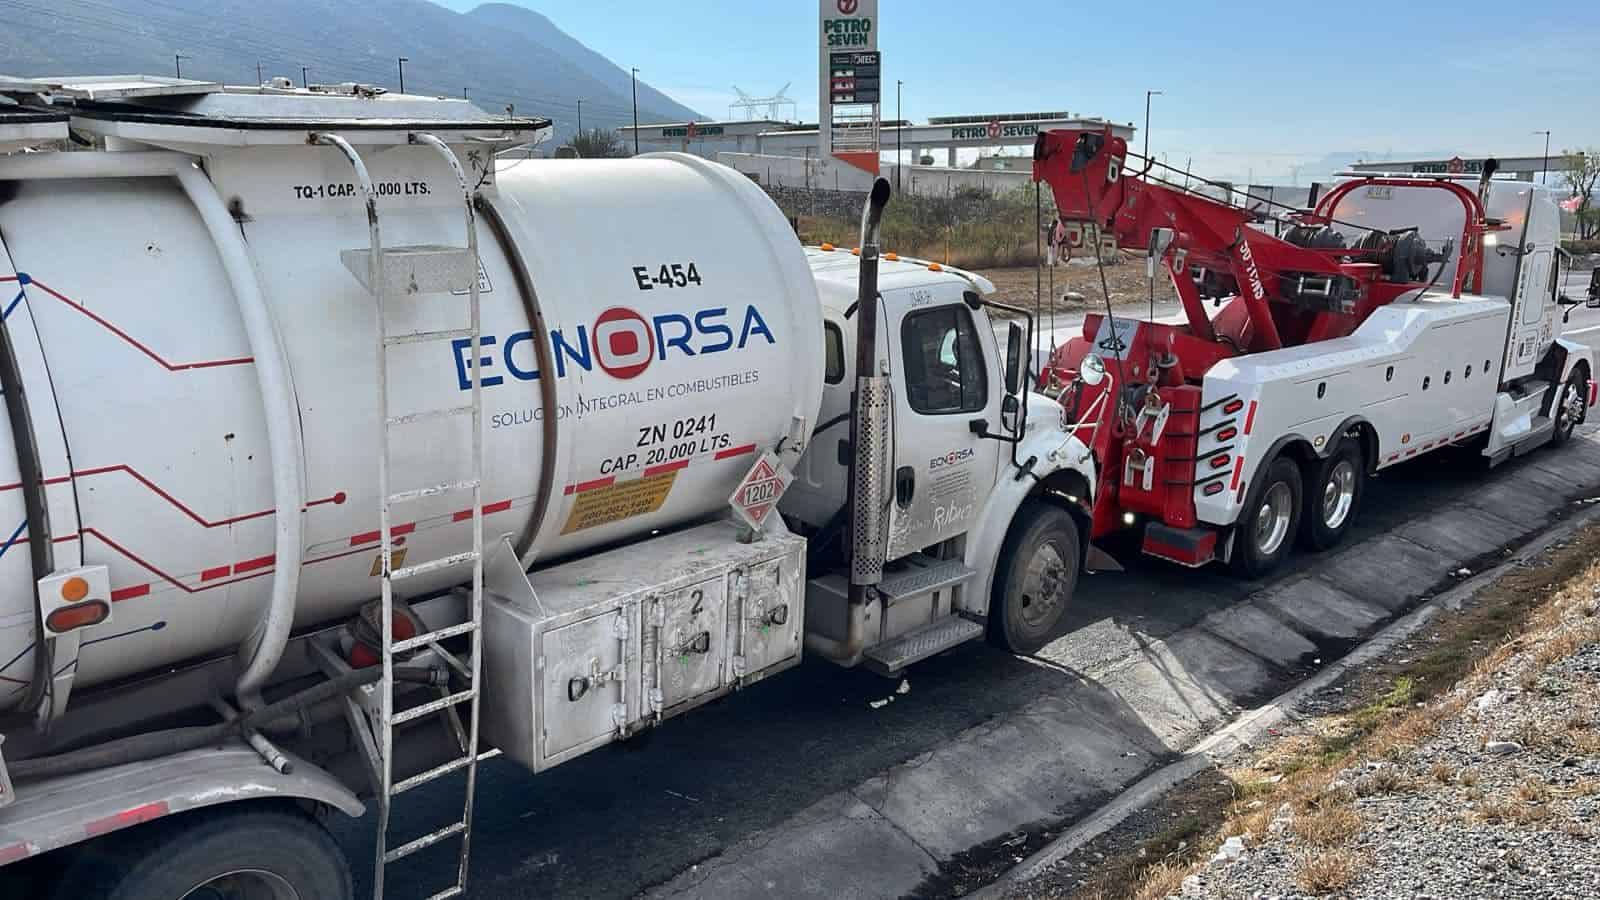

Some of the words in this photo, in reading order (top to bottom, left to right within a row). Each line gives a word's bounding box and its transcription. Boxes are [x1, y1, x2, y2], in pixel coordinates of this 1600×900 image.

[823, 18, 872, 34] PETRO
[827, 33, 868, 46] SEVEN
[951, 127, 986, 138] PETRO
[1003, 124, 1039, 136] SEVEN
[1412, 162, 1448, 173] PETRO
[294, 185, 325, 199] TQ-1
[327, 183, 356, 198] CAP.
[360, 182, 401, 199] ,000
[405, 182, 431, 196] LTS.
[632, 262, 702, 291] E-454
[452, 304, 776, 391] ECNORSA
[647, 386, 665, 401] EN
[667, 370, 760, 398] COMBUSTIBLES
[637, 423, 667, 447] ZN
[673, 413, 716, 439] 0241
[600, 453, 640, 475] CAP.
[646, 440, 696, 465] 20,000
[700, 433, 732, 453] LTS.
[746, 481, 774, 504] 1202
[690, 590, 704, 615] 2
